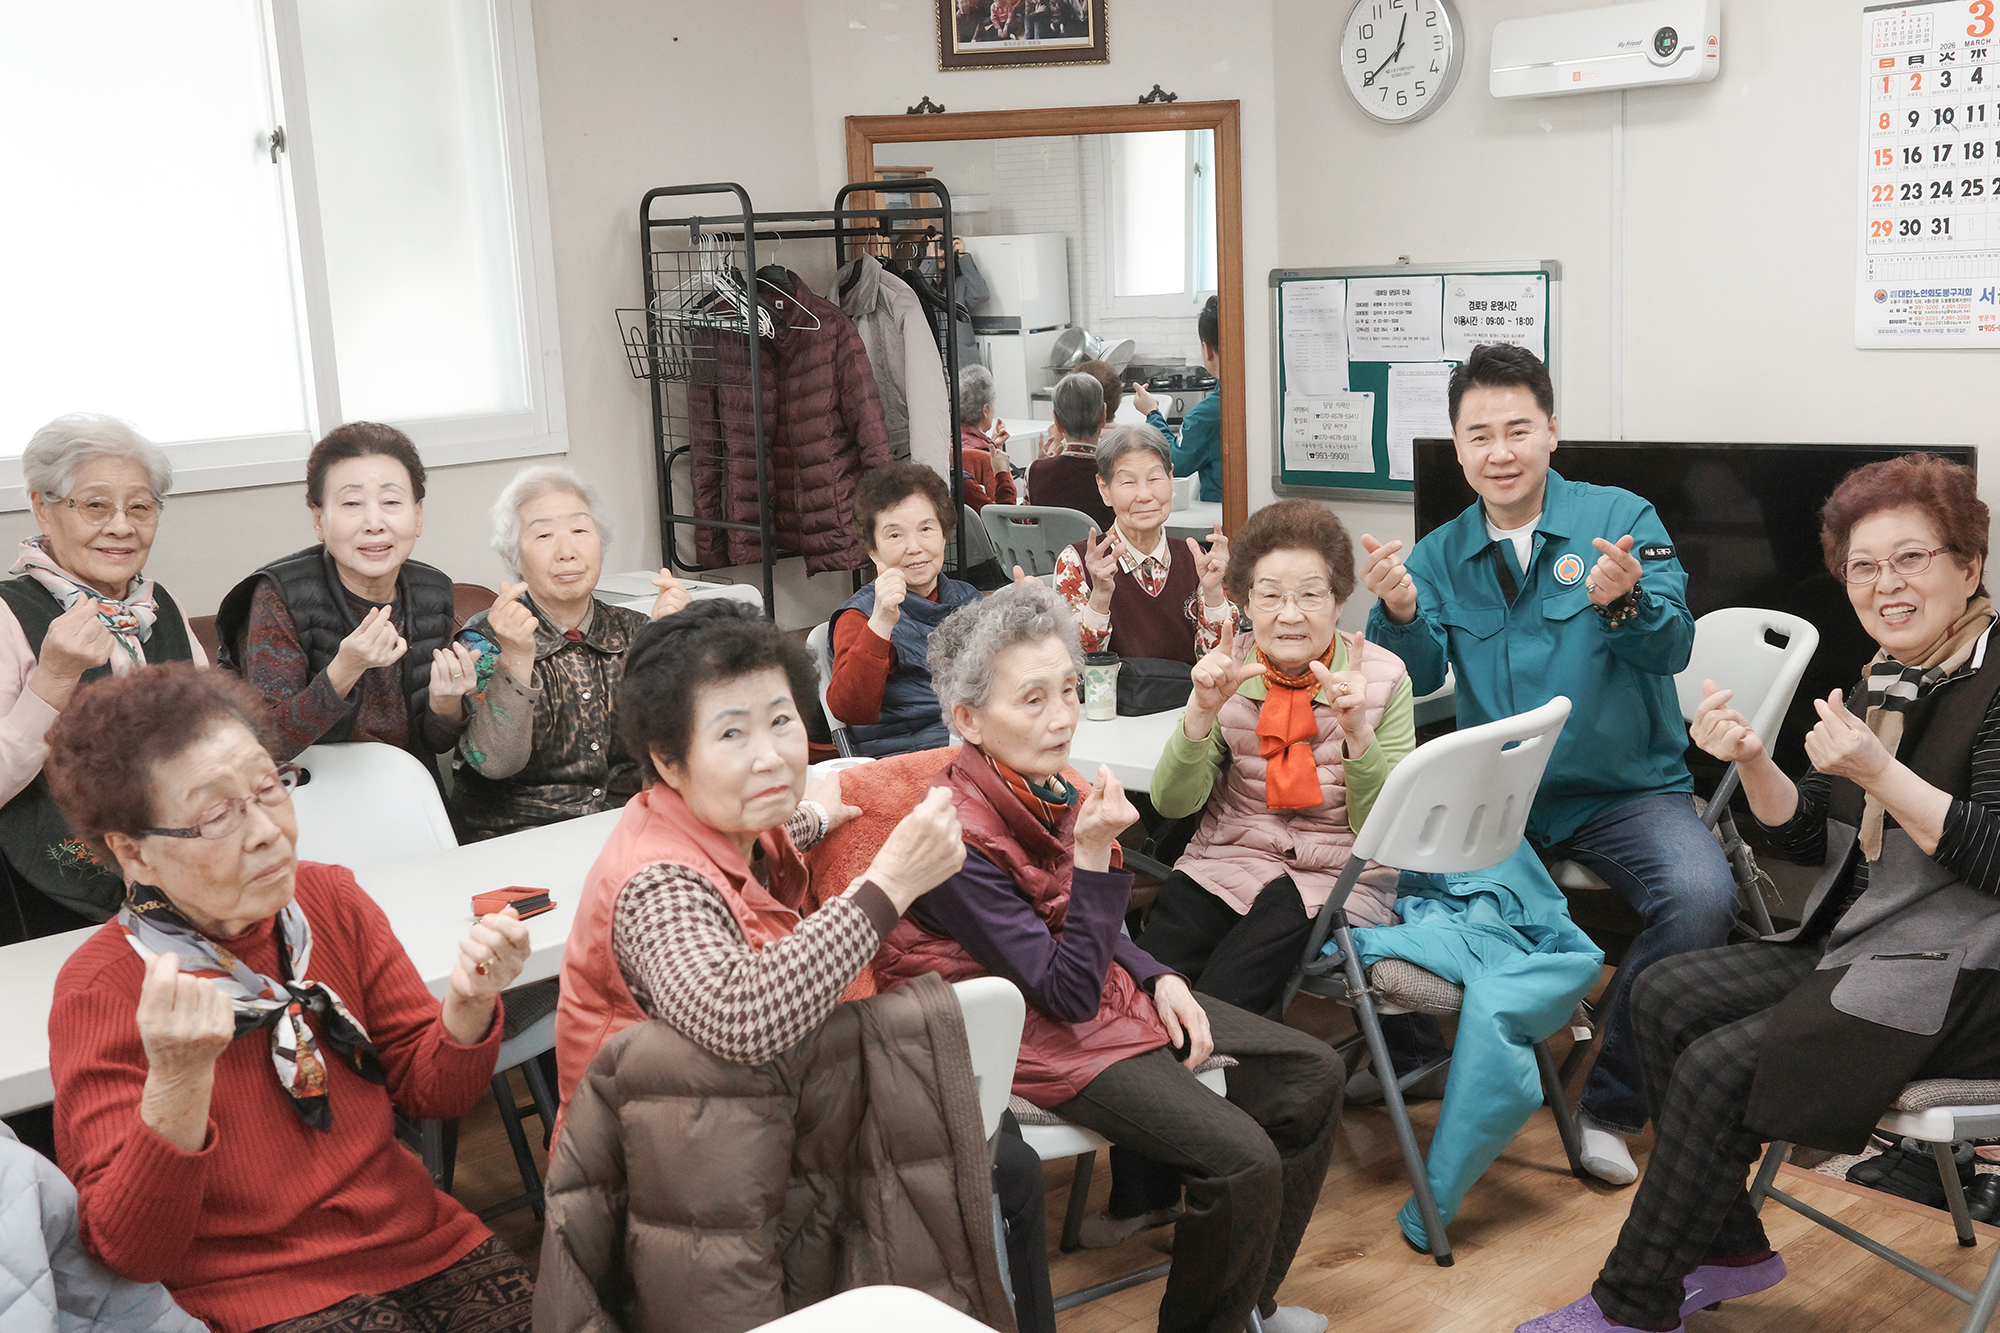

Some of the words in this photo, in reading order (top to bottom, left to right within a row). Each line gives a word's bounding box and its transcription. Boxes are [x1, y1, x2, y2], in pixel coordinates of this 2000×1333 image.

[1373, 4, 1382, 20] 11
[1426, 11, 1436, 27] 2
[1966, 0, 1994, 37] 3
[1359, 24, 1373, 40] 10
[1433, 35, 1444, 51] 3
[1965, 38, 1991, 47] MARCH
[1356, 48, 1366, 63] 9
[1879, 58, 1895, 68] 日
[1908, 55, 1924, 65] 月
[1939, 52, 1955, 62] 火
[1970, 49, 1987, 58] 水
[1430, 59, 1439, 73] 4
[1883, 76, 1889, 93] 1
[1910, 73, 1922, 91] 2
[1940, 71, 1951, 88] 3
[1971, 67, 1983, 84] 4
[1379, 87, 1388, 102] 7
[1415, 81, 1426, 96] 5
[1396, 90, 1407, 106] 6
[1879, 112, 1890, 130] 8
[1908, 110, 1920, 127] 9
[1935, 107, 1954, 125] 10
[1967, 104, 1984, 122] 11
[1875, 148, 1893, 166] 15
[1903, 146, 1922, 164] 16
[1933, 144, 1953, 162] 17
[1964, 142, 1984, 160] 18
[1872, 185, 1894, 202] 22
[1900, 183, 1922, 200] 23
[1930, 181, 1953, 199] 24
[1961, 179, 1984, 196] 25
[1871, 220, 1893, 237] 29
[1899, 219, 1921, 236] 30
[1931, 218, 1950, 234] 31
[1898, 288, 1972, 298] 대한노인회도봉구지회
[1469, 301, 1488, 311] 경로당
[1490, 301, 1517, 311] 운영시간
[1454, 316, 1478, 326] 이용시간
[1486, 317, 1505, 326] 09:00
[1516, 317, 1534, 326] 18:00
